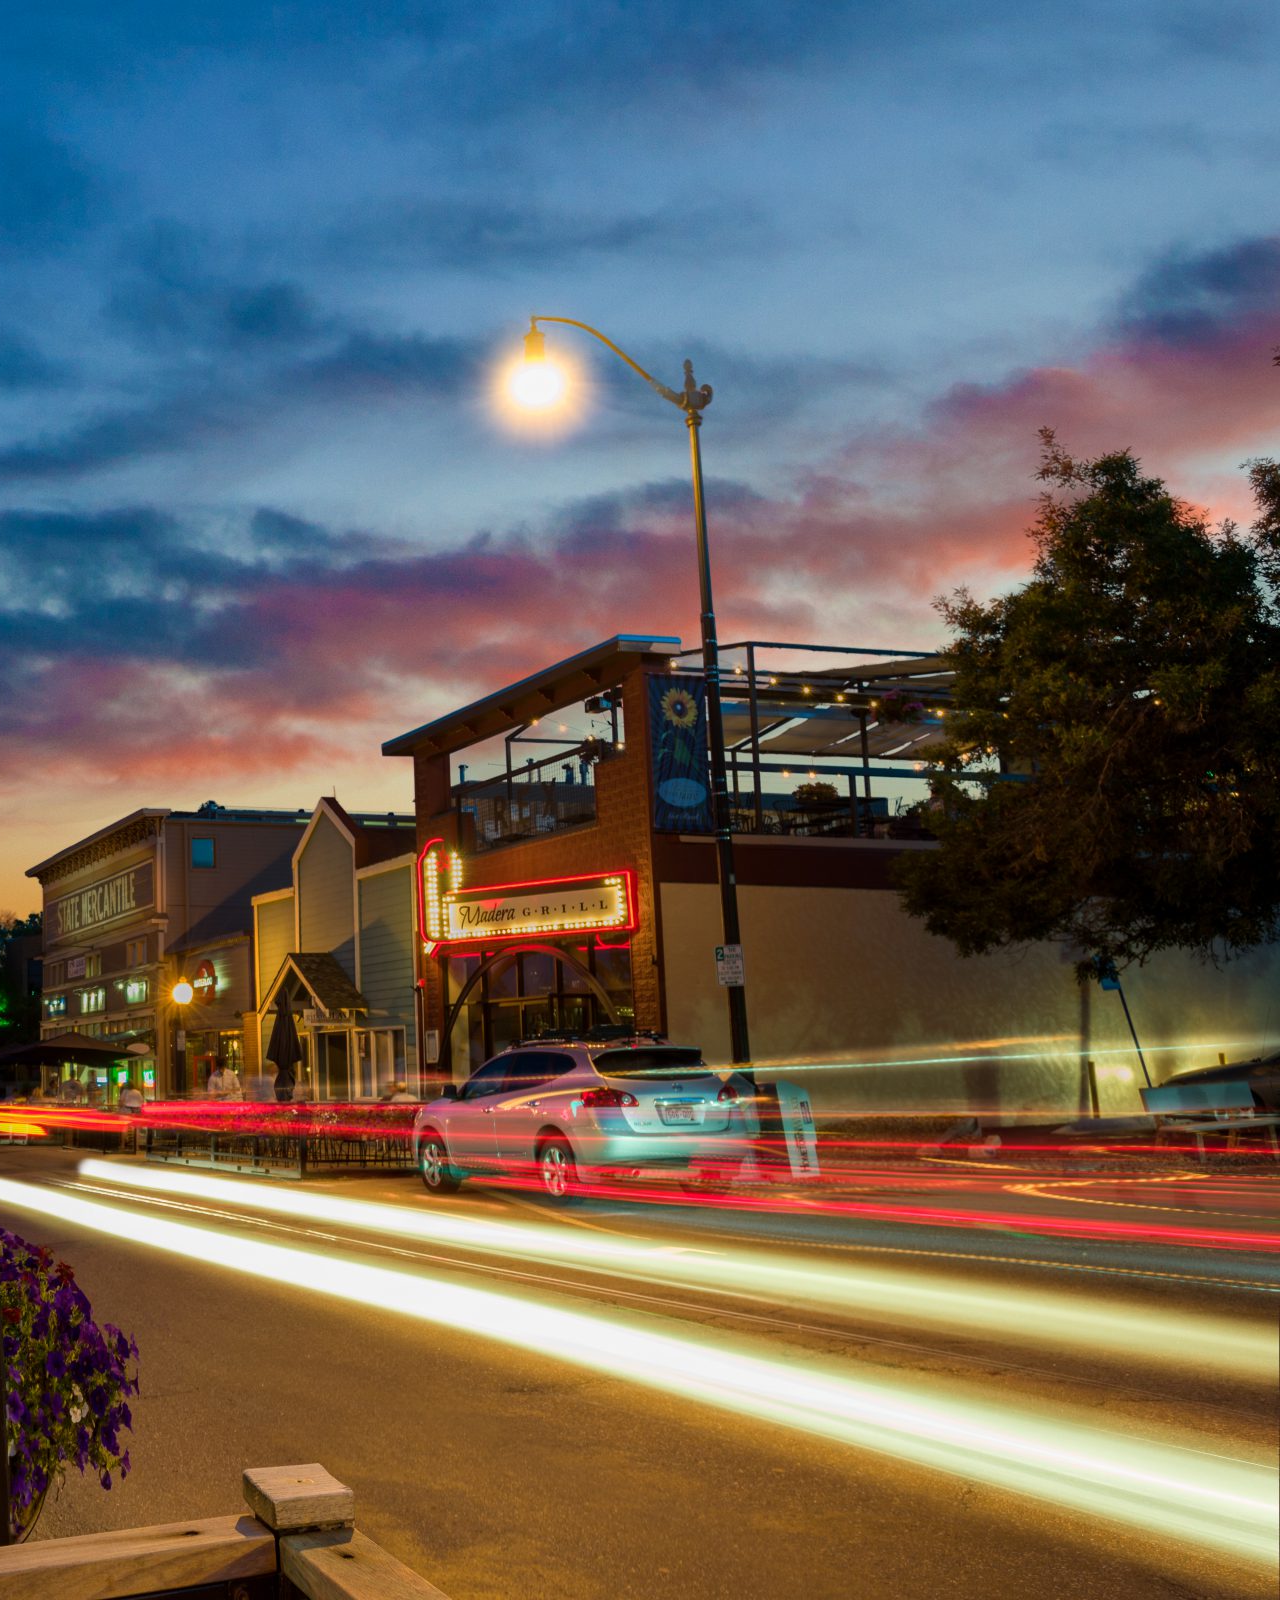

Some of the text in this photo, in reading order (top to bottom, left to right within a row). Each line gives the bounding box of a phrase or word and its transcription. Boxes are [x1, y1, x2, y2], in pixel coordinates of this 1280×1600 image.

[57, 872, 136, 935] STATE MERCANTILE
[458, 903, 516, 930] Madera
